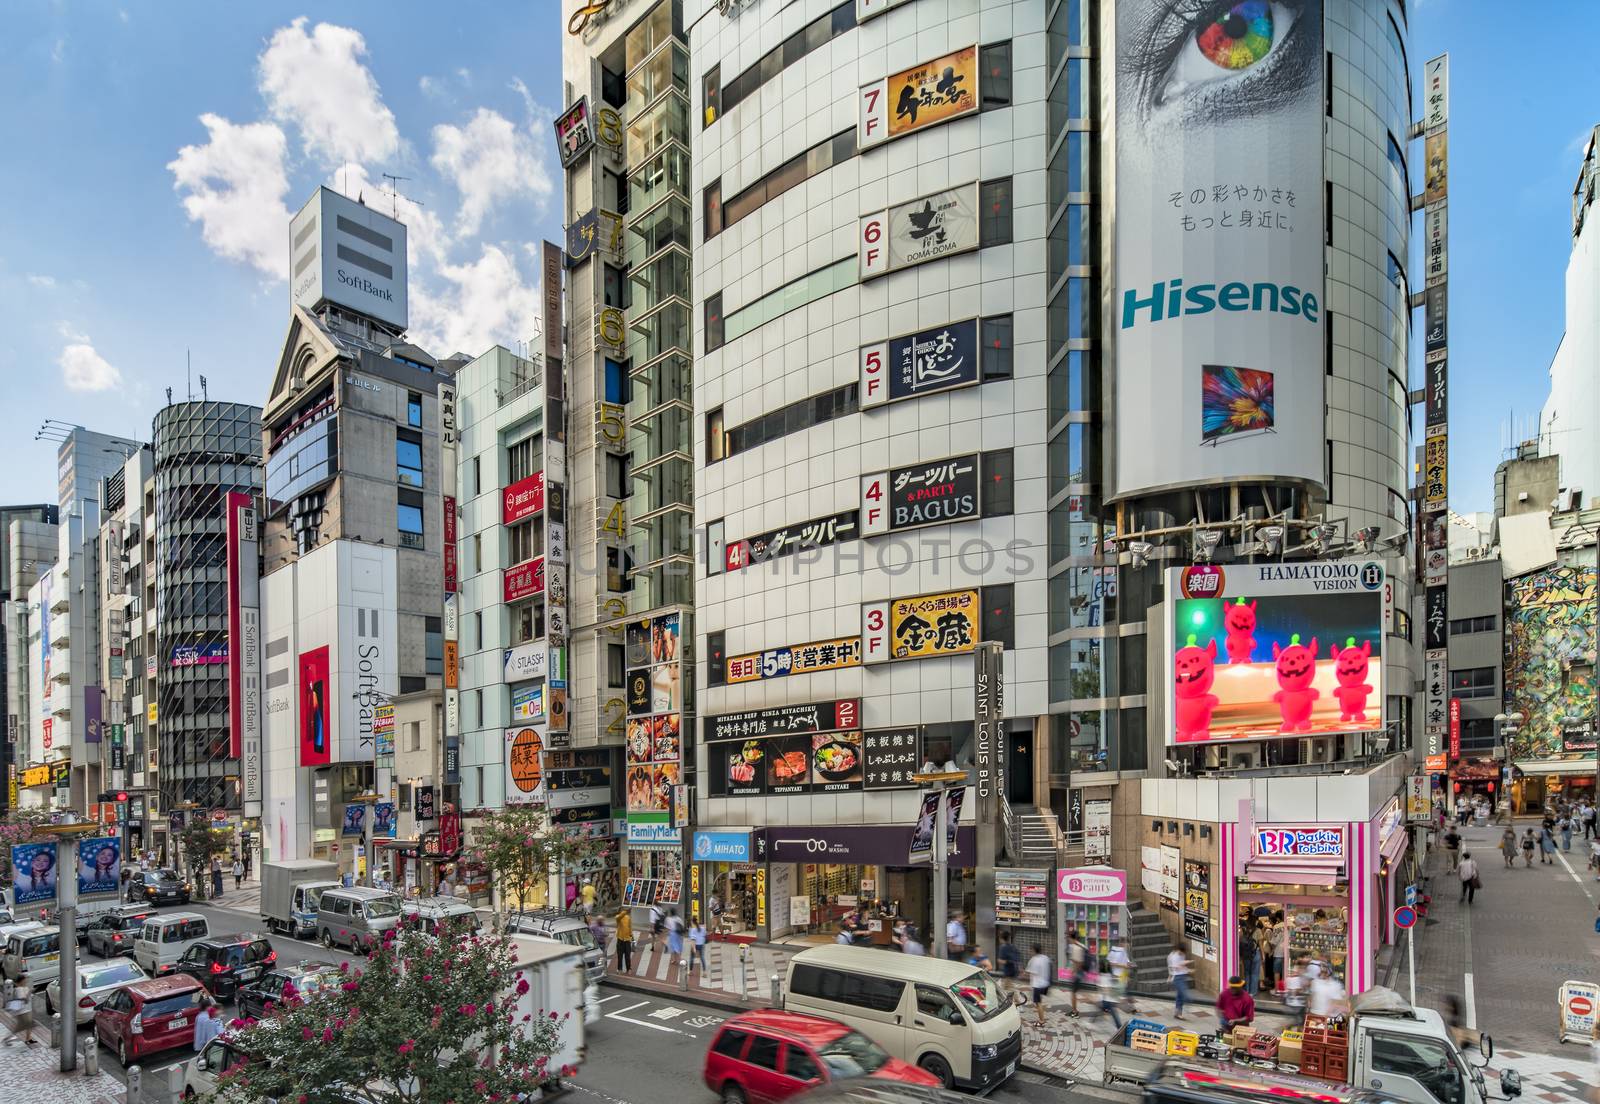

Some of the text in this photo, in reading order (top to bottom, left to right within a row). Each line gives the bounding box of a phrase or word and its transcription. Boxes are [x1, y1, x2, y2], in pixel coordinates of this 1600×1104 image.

[1168, 184, 1296, 208] その彩やかさを
[1181, 210, 1294, 232] もっと身近に。
[864, 221, 881, 267] 6F
[907, 242, 957, 262] DOMA-DOMA
[338, 269, 393, 302] SoftBank
[1122, 278, 1318, 329] Hisense
[600, 308, 624, 346] 6
[866, 351, 881, 397] 5F
[1434, 361, 1445, 409] ダーツバー
[601, 403, 624, 442] 5
[894, 463, 972, 492] ダーツバー
[917, 483, 955, 499] PARTY
[866, 480, 883, 525] 4F
[896, 495, 974, 525] BAGUS
[602, 501, 624, 537] 4
[770, 519, 855, 555] ダーツバー
[1260, 564, 1358, 581] HAMATOMO
[1314, 579, 1357, 590] VISION
[898, 596, 958, 615] きんくら酒場
[867, 610, 884, 653] 3F
[897, 611, 971, 651] 金の蔵
[246, 626, 256, 667] SoftBank
[266, 697, 290, 715] SoftBank
[357, 644, 380, 749] SoftBank
[782, 706, 817, 714] MIYACHIKU
[246, 690, 256, 733] SoftBank
[604, 698, 626, 733] 2
[839, 702, 854, 728] 2F
[716, 720, 767, 737] 宮崎牛専門店
[865, 734, 914, 748] 鉄板焼き
[978, 674, 989, 797] SAINT LOUIS BLD
[868, 752, 915, 765] しゃぶしゃぶ
[247, 755, 257, 797] SoftBank
[867, 770, 914, 783] すき焼き
[631, 824, 678, 840] FamilyMart
[1260, 832, 1294, 854] BR
[1297, 830, 1339, 842] baskin
[714, 845, 745, 855] MIHATO
[1298, 842, 1342, 854] robbins
